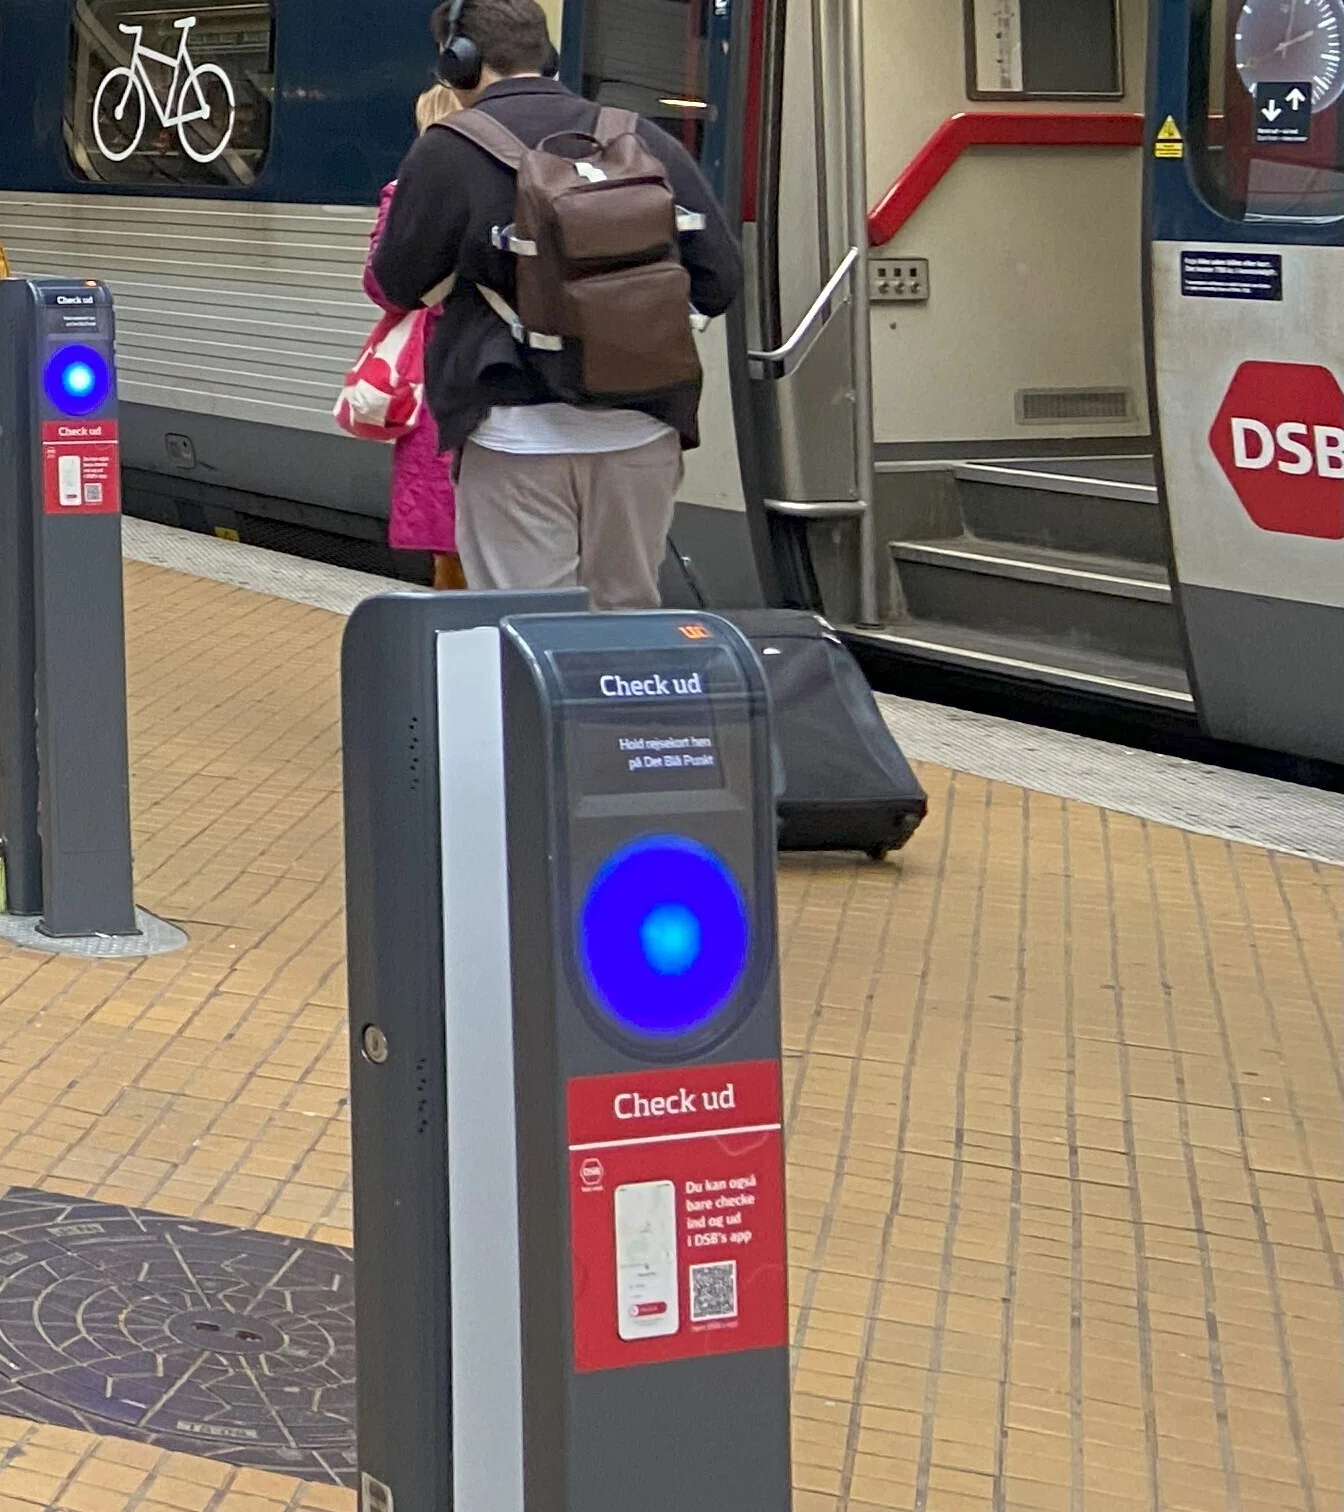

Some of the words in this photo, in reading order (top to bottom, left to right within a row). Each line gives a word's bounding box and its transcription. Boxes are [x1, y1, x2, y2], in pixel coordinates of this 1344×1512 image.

[57, 295, 81, 305] Check
[82, 295, 94, 305] ud
[58, 426, 88, 437] Check
[89, 425, 102, 436] ud
[1230, 416, 1344, 479] DSB
[599, 673, 671, 697] Check
[672, 672, 703, 695] ud
[619, 737, 644, 750] Hold
[614, 1088, 697, 1120] Check
[700, 1082, 736, 1110] ud
[685, 1181, 703, 1194] Du
[705, 1179, 727, 1191] kan
[728, 1174, 757, 1190] også
[685, 1199, 713, 1212] bare
[715, 1193, 755, 1208] checke
[686, 1215, 706, 1229] ind
[708, 1216, 724, 1228] og
[725, 1211, 742, 1225] ud
[694, 1232, 728, 1247] DSB's
[729, 1230, 753, 1245] app
